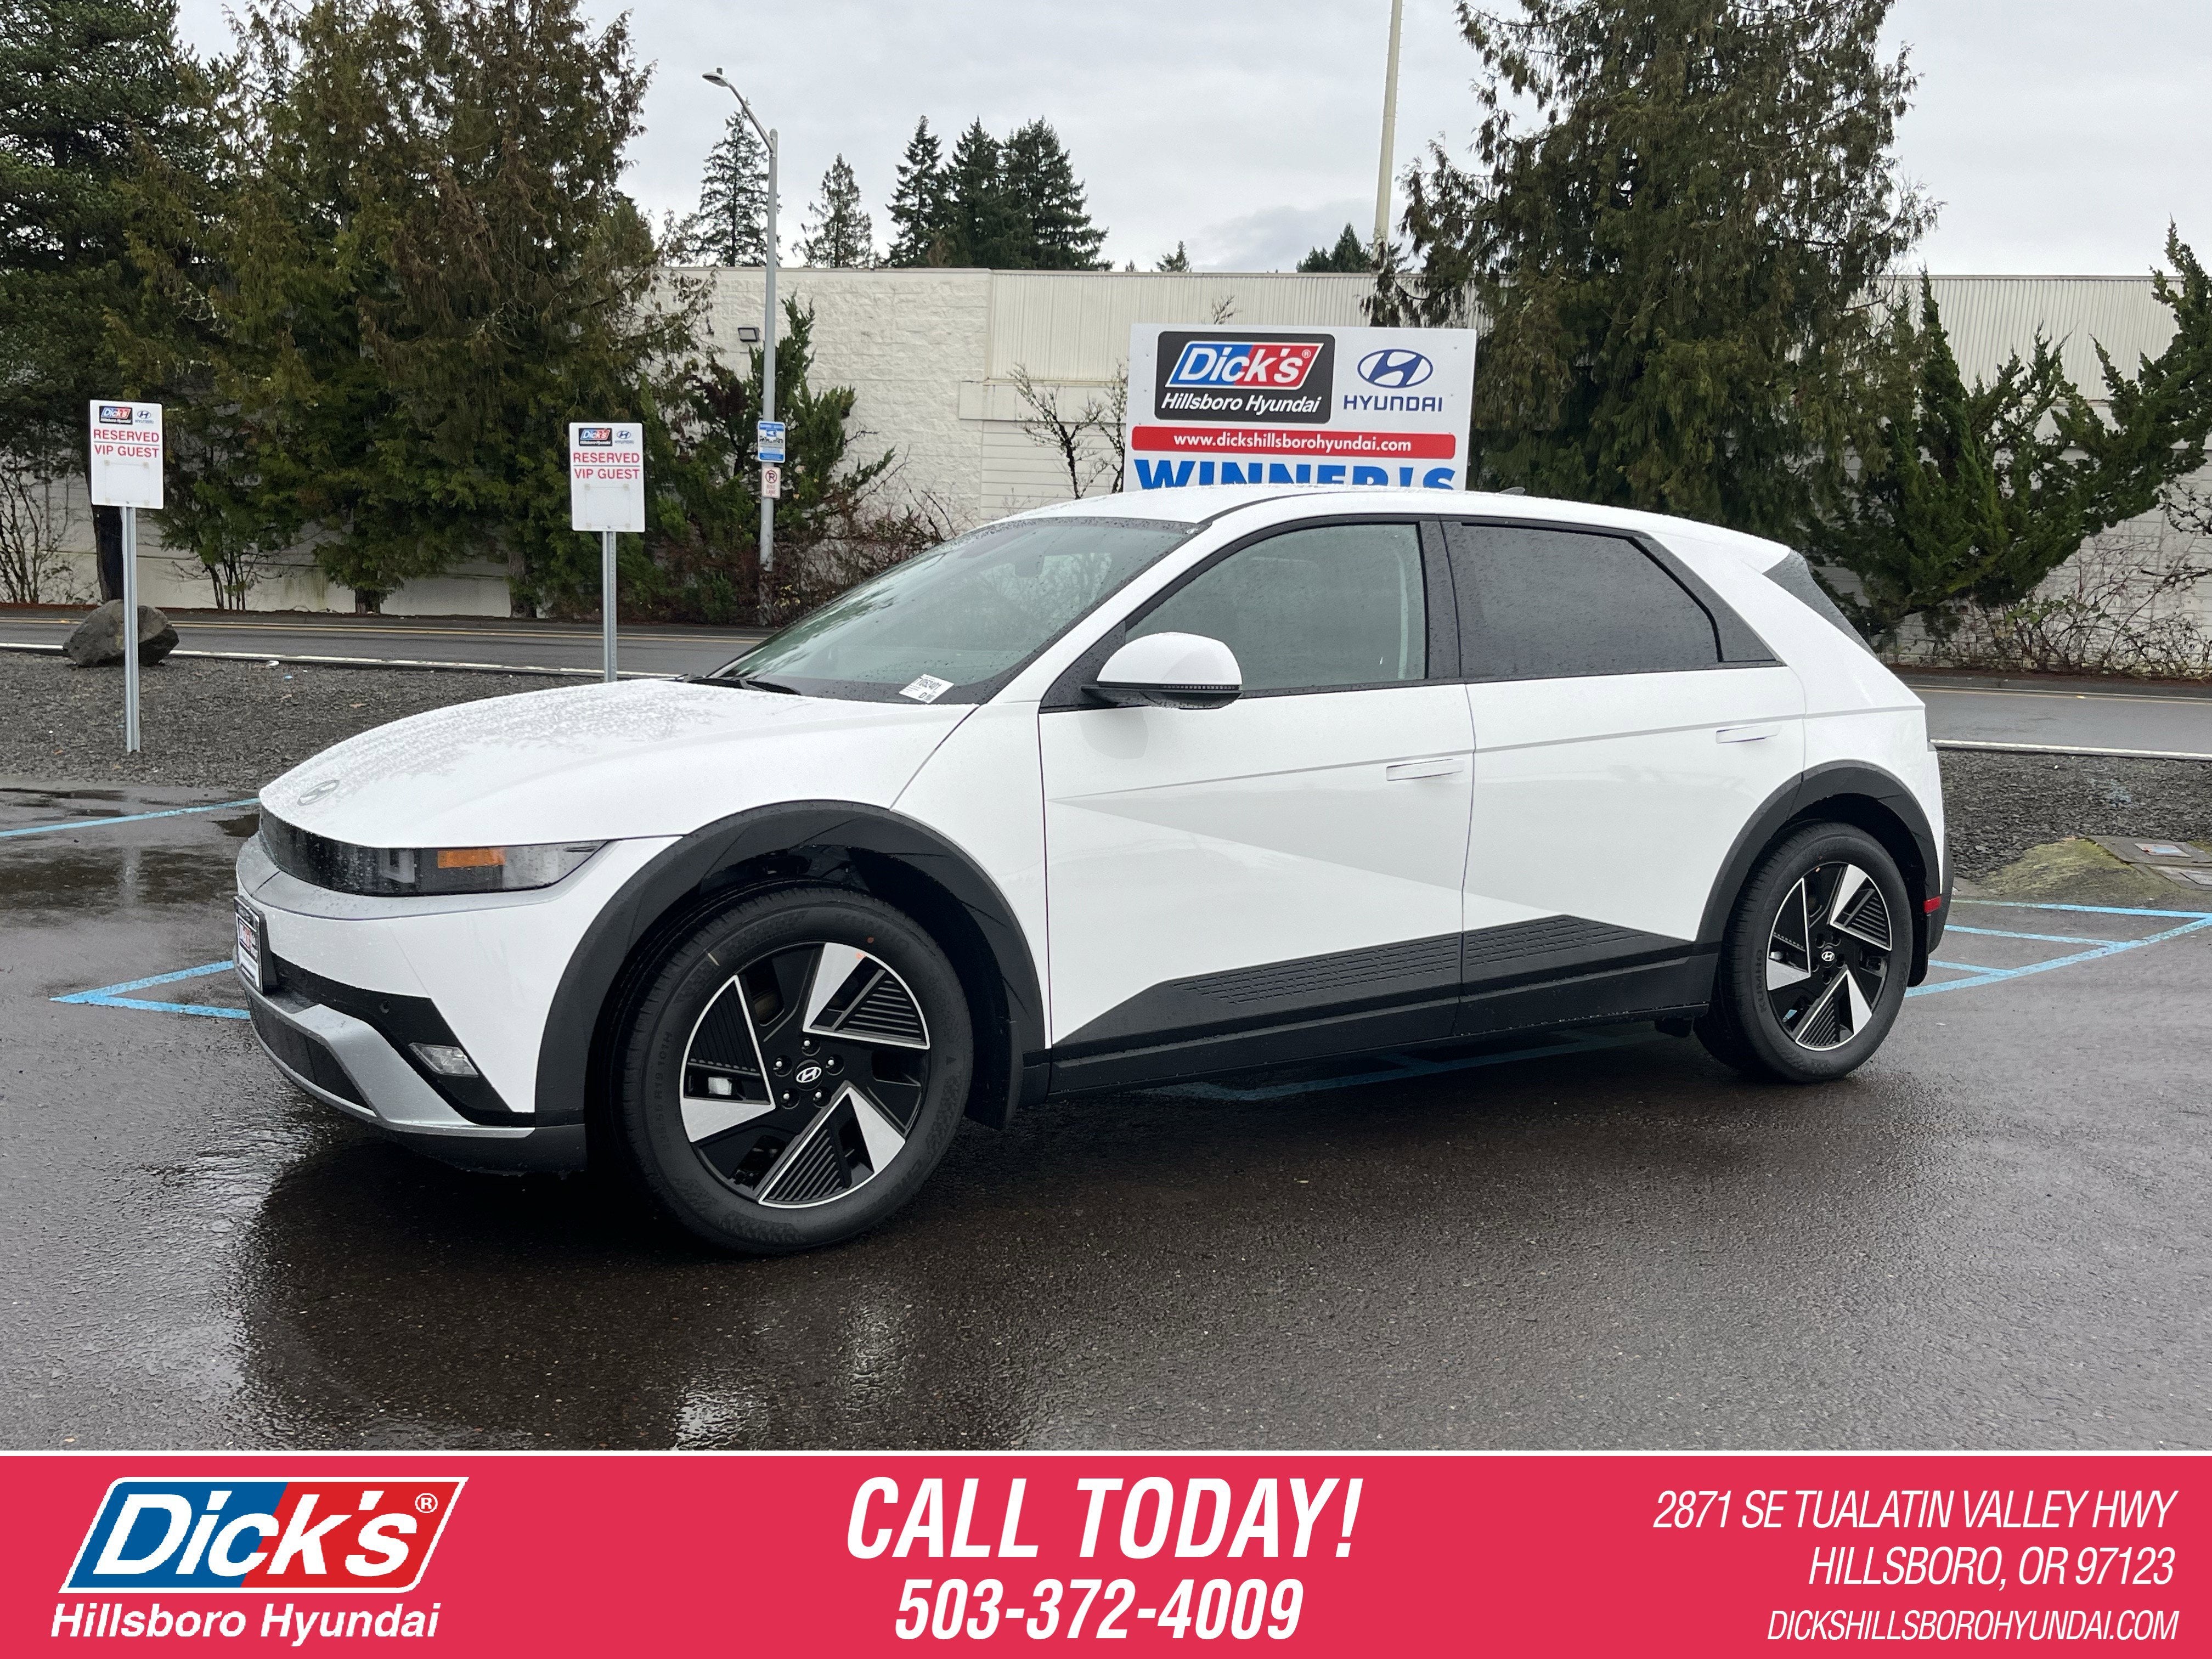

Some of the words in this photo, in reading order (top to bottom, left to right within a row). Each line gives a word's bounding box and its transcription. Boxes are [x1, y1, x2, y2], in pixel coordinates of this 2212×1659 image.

[1161, 392, 1242, 412] Hillsboro
[1245, 394, 1322, 417] Hyundai
[1343, 394, 1443, 413] HYUNDAI
[94, 428, 160, 443] RESERVED
[1173, 431, 1412, 454] www.dickshillsborohyundai.com
[94, 444, 114, 455] VIP
[117, 446, 159, 458] GUEST
[573, 452, 640, 464] RESERVED
[574, 469, 593, 479] VIP
[597, 469, 640, 480] GUEST
